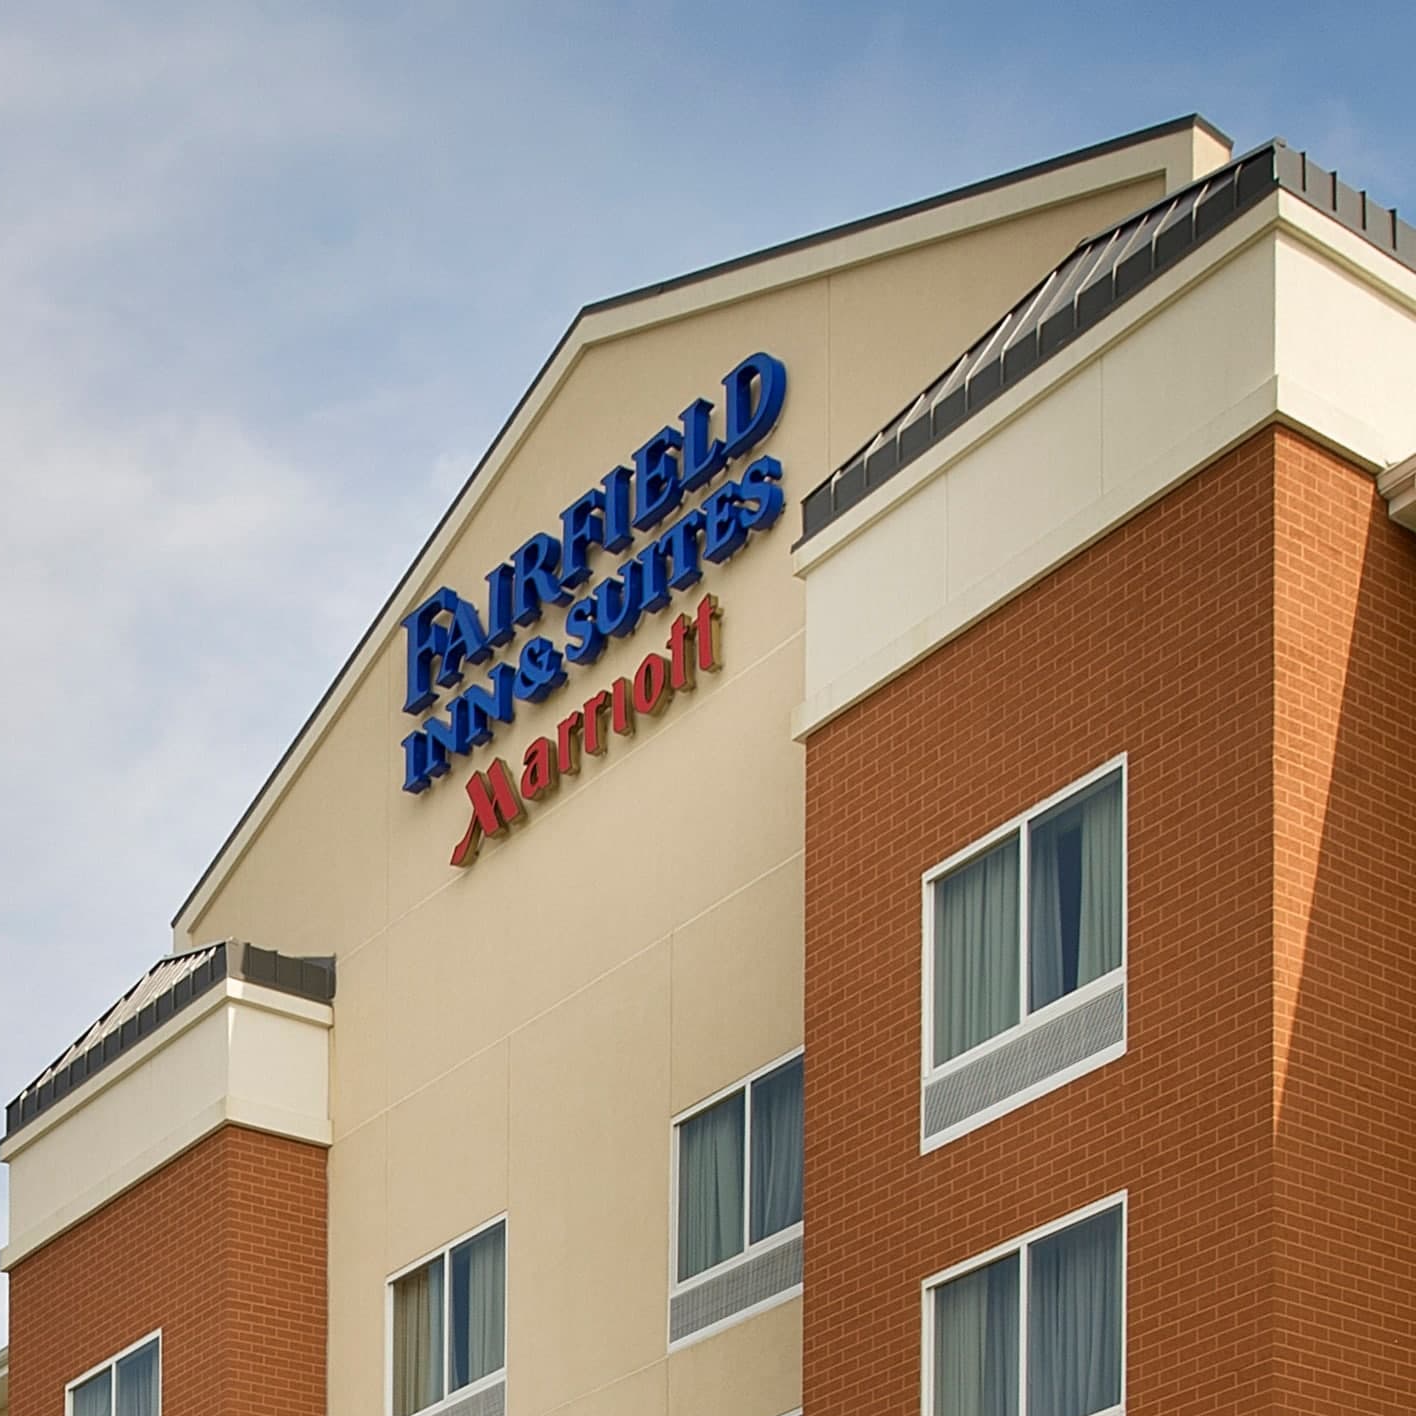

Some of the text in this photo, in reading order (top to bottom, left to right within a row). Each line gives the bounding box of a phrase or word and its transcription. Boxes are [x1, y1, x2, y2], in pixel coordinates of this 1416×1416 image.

[401, 352, 787, 715] FAIRFIELD
[401, 455, 785, 794] INN & SUITES
[450, 592, 722, 866] Marriott
